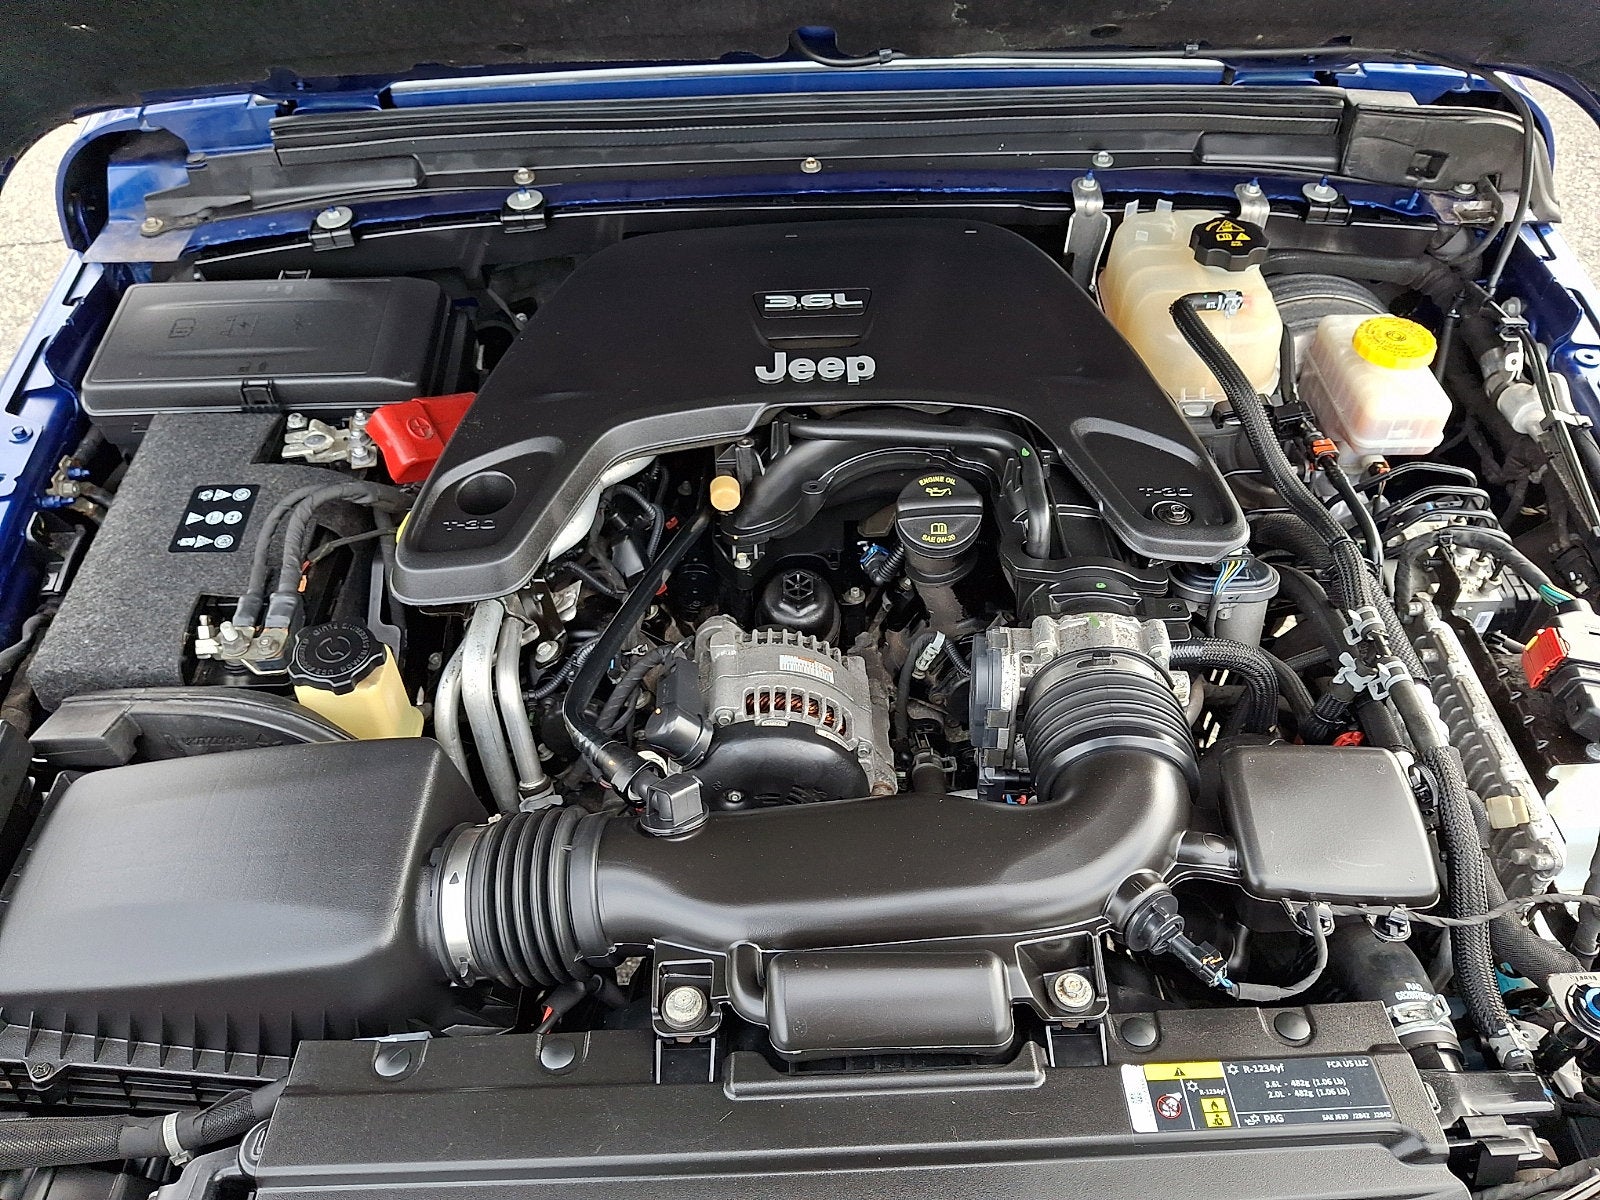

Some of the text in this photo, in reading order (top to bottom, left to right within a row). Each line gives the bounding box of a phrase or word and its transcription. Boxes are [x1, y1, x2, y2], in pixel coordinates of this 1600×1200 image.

[765, 293, 863, 310] 3.6L
[755, 351, 876, 385] Jeep
[918, 476, 956, 486] ENGINE OIL
[921, 534, 956, 544] SAE 0W-20
[1242, 1063, 1285, 1074] R-1234yf
[1326, 1059, 1369, 1069] FCA US LLC
[1264, 1081, 1282, 1089] 3.6L
[1268, 1090, 1286, 1099] 2.0L
[1264, 1114, 1285, 1124] PAG
